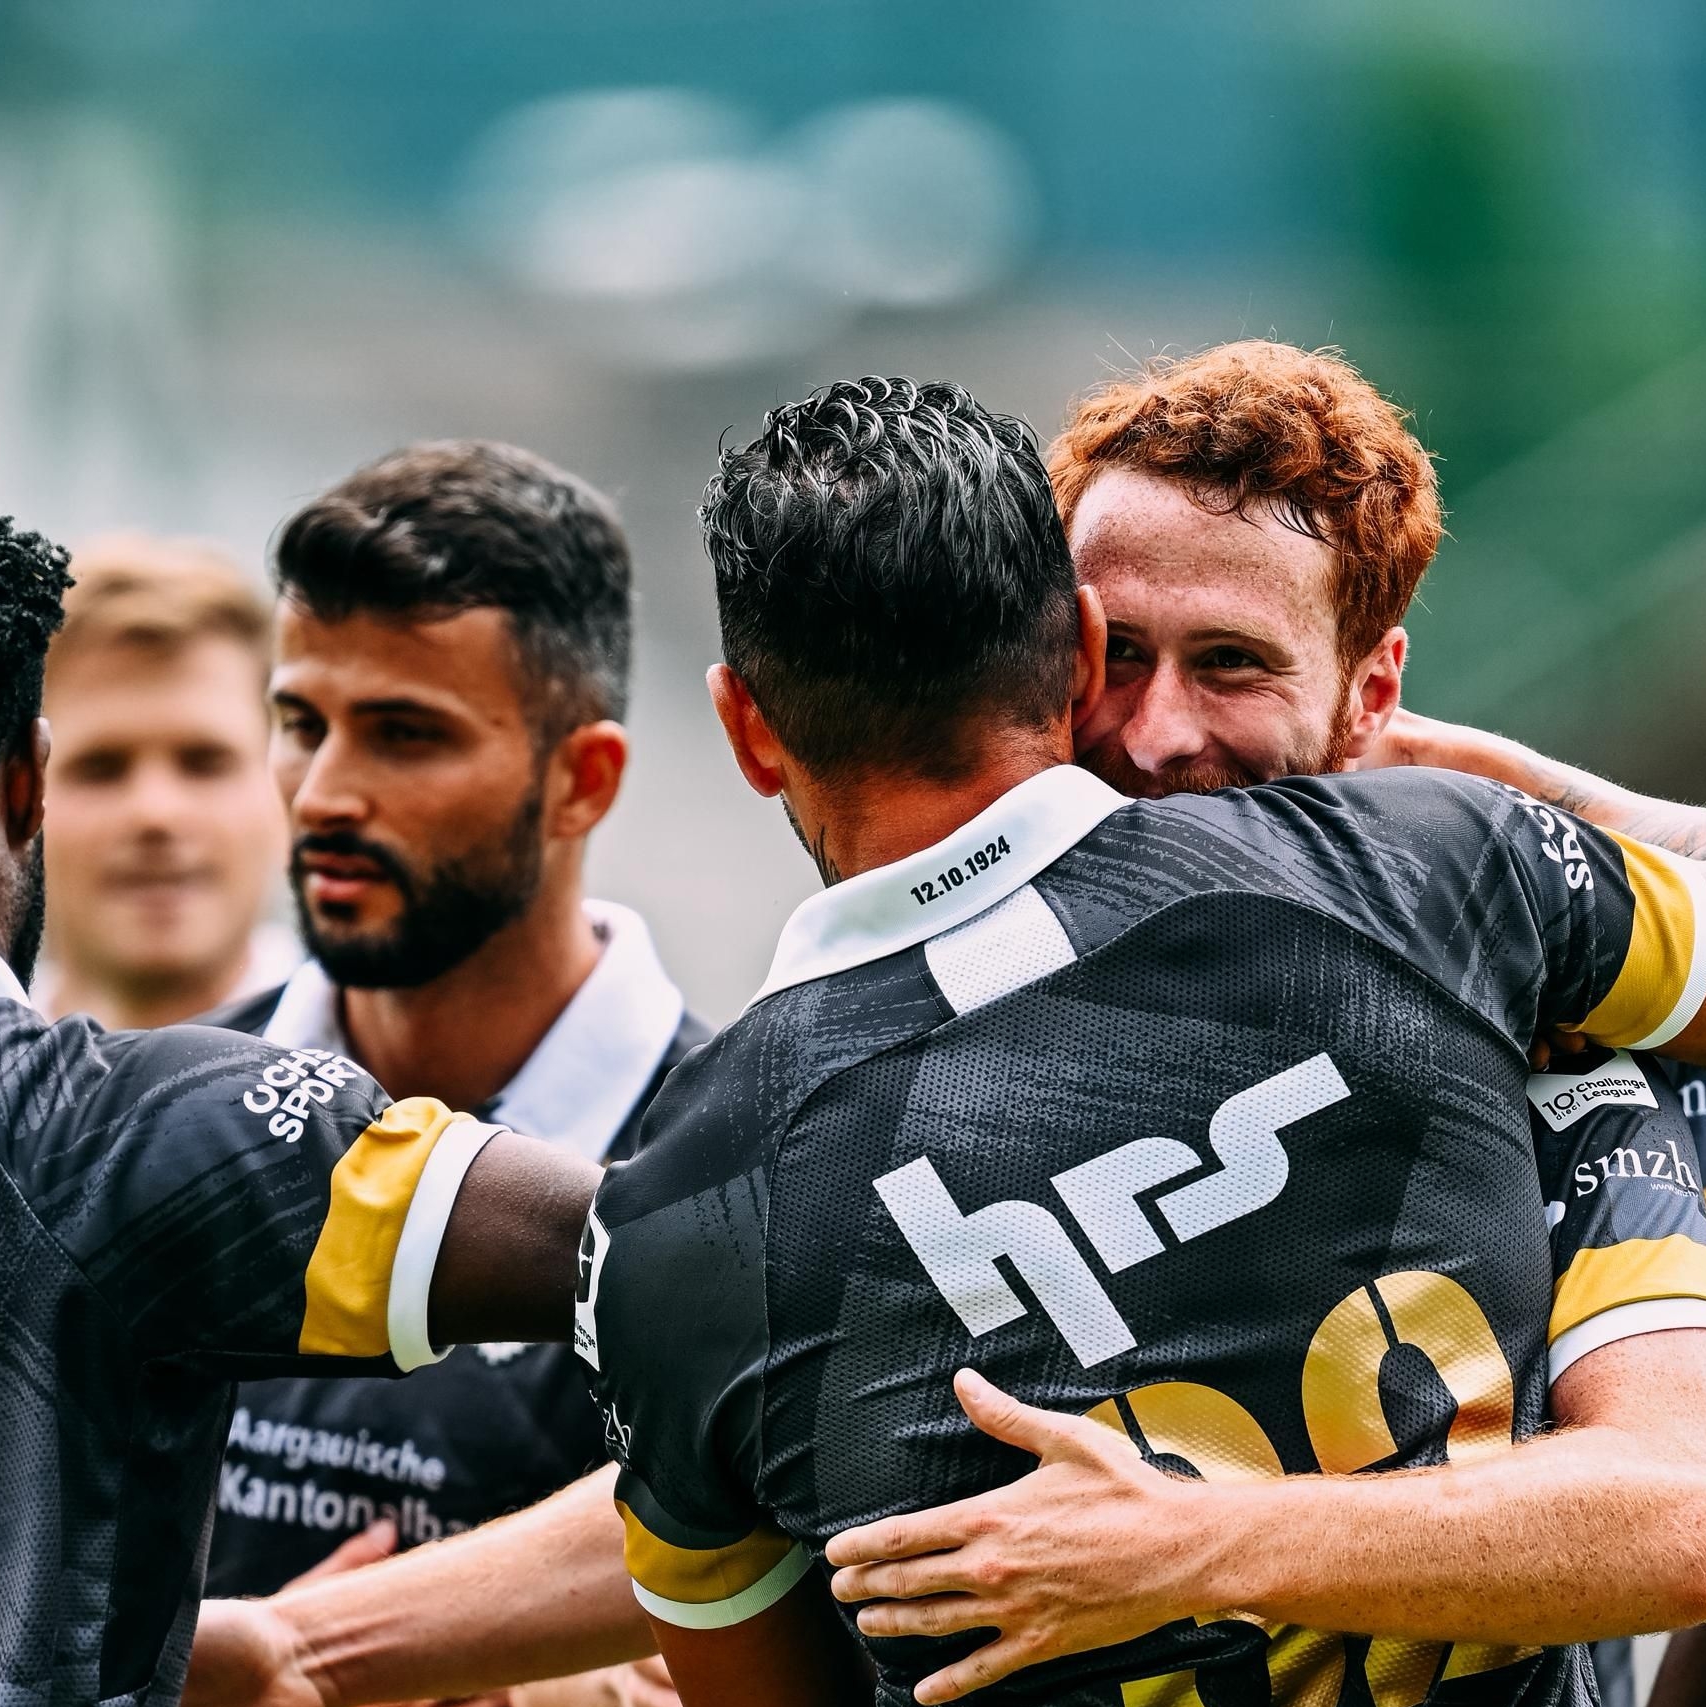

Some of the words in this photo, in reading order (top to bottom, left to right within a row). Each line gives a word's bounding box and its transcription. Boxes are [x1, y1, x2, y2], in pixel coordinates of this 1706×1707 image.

[910, 834, 1011, 906] 12.10.1924
[268, 1055, 367, 1143] SPORT
[1556, 1102, 1581, 1120] dieci
[1576, 1078, 1647, 1093] Challenge
[1582, 1089, 1636, 1102] League
[1575, 1140, 1699, 1197] smzh
[872, 1051, 1352, 1370] hrs
[226, 1406, 446, 1491] Aargauische
